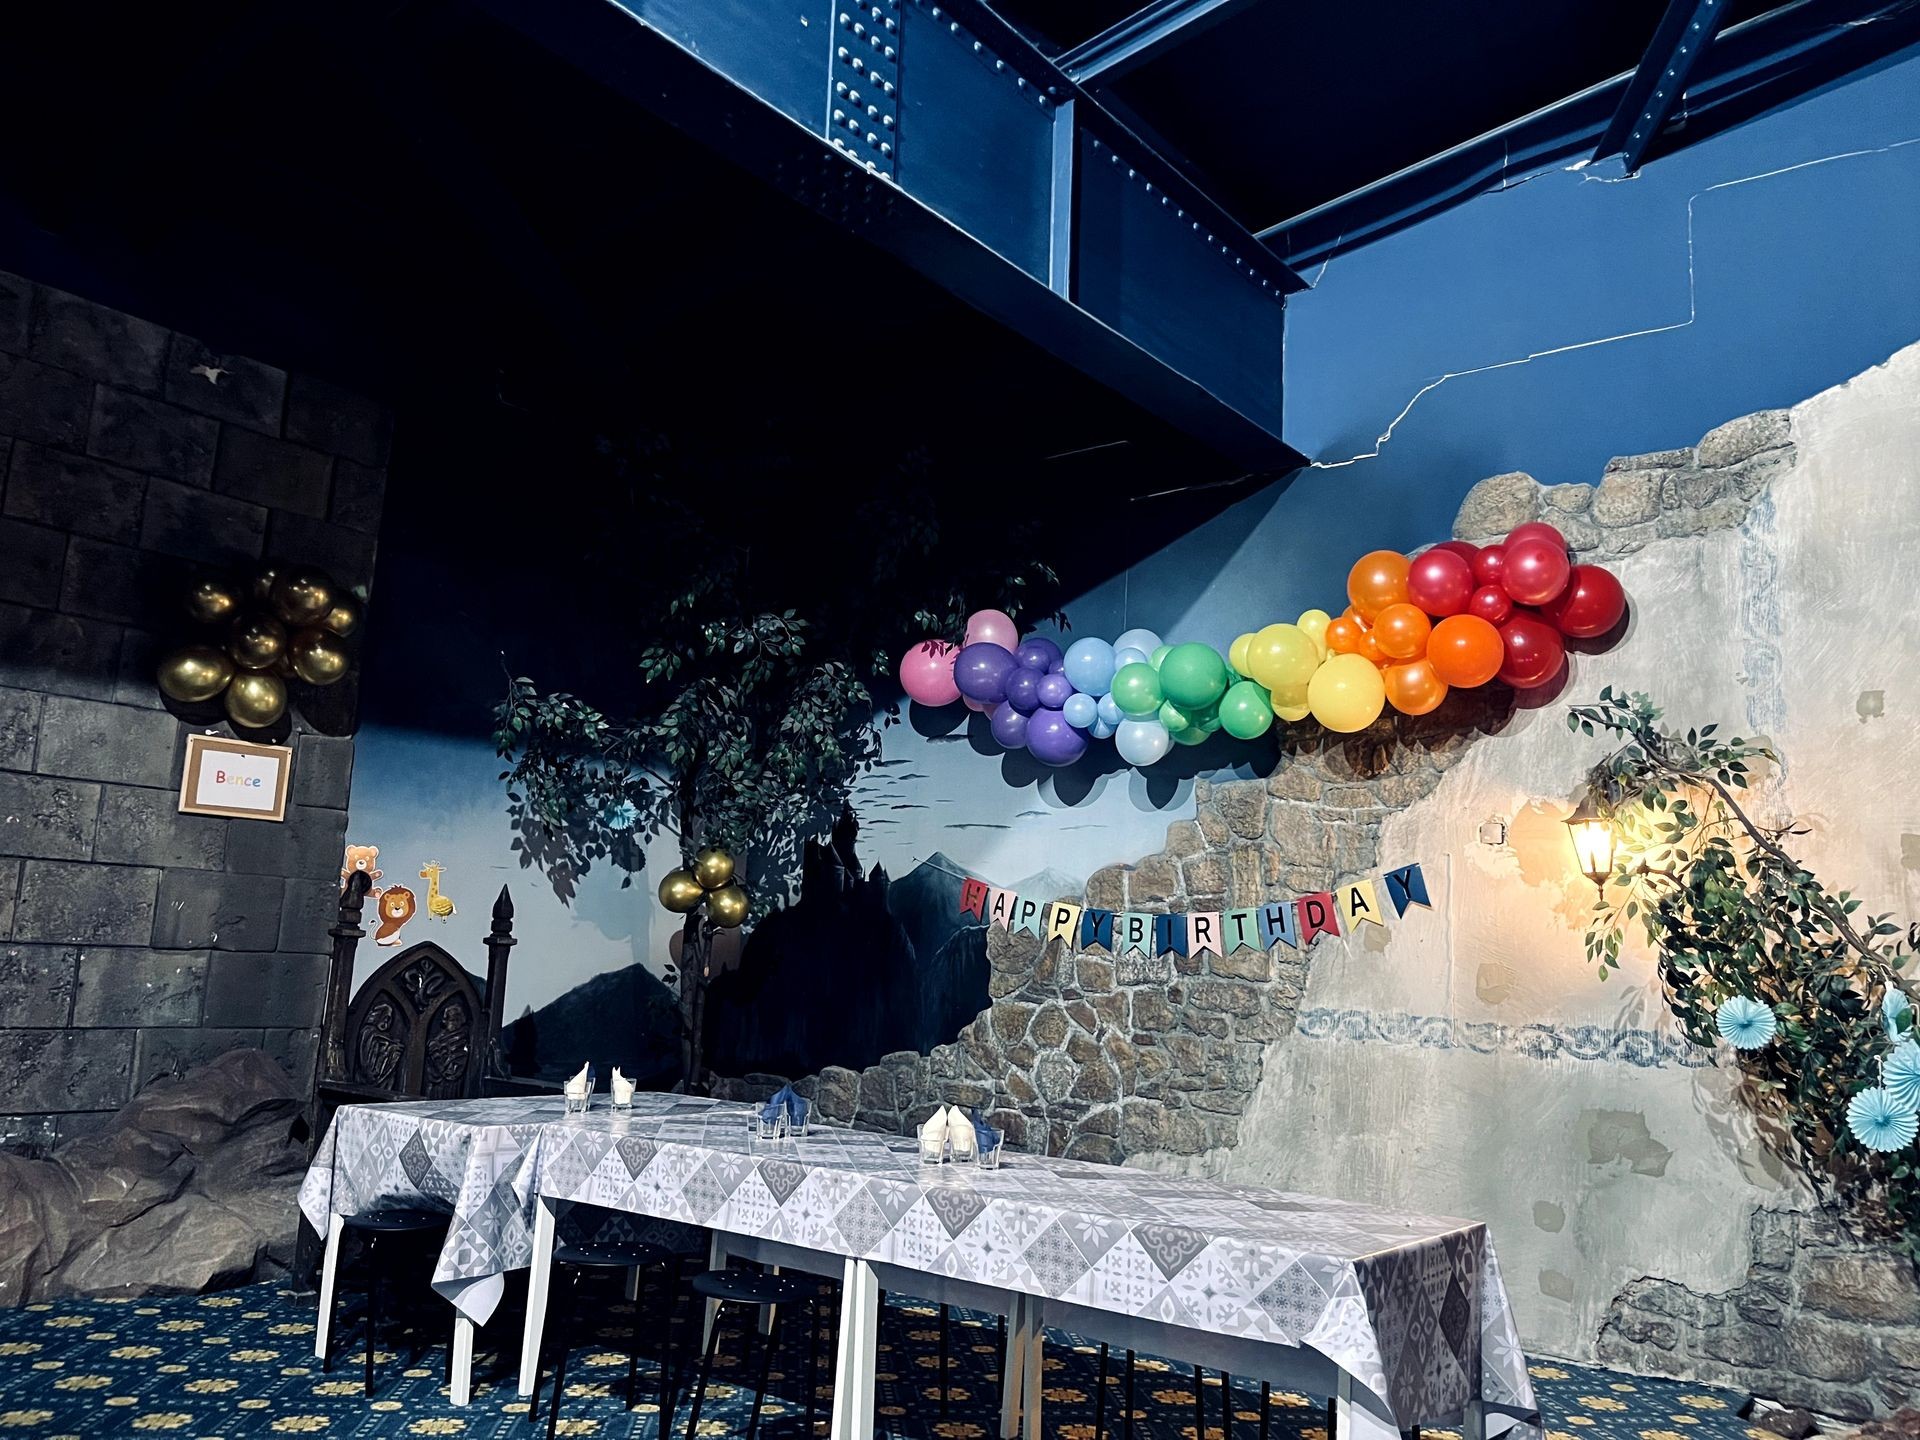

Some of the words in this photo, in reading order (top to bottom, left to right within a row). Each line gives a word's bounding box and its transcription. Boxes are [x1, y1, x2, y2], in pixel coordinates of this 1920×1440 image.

[216, 770, 261, 788] Bence
[965, 883, 1107, 938] HAPPY
[1129, 869, 1411, 945] BIRTHDAY
